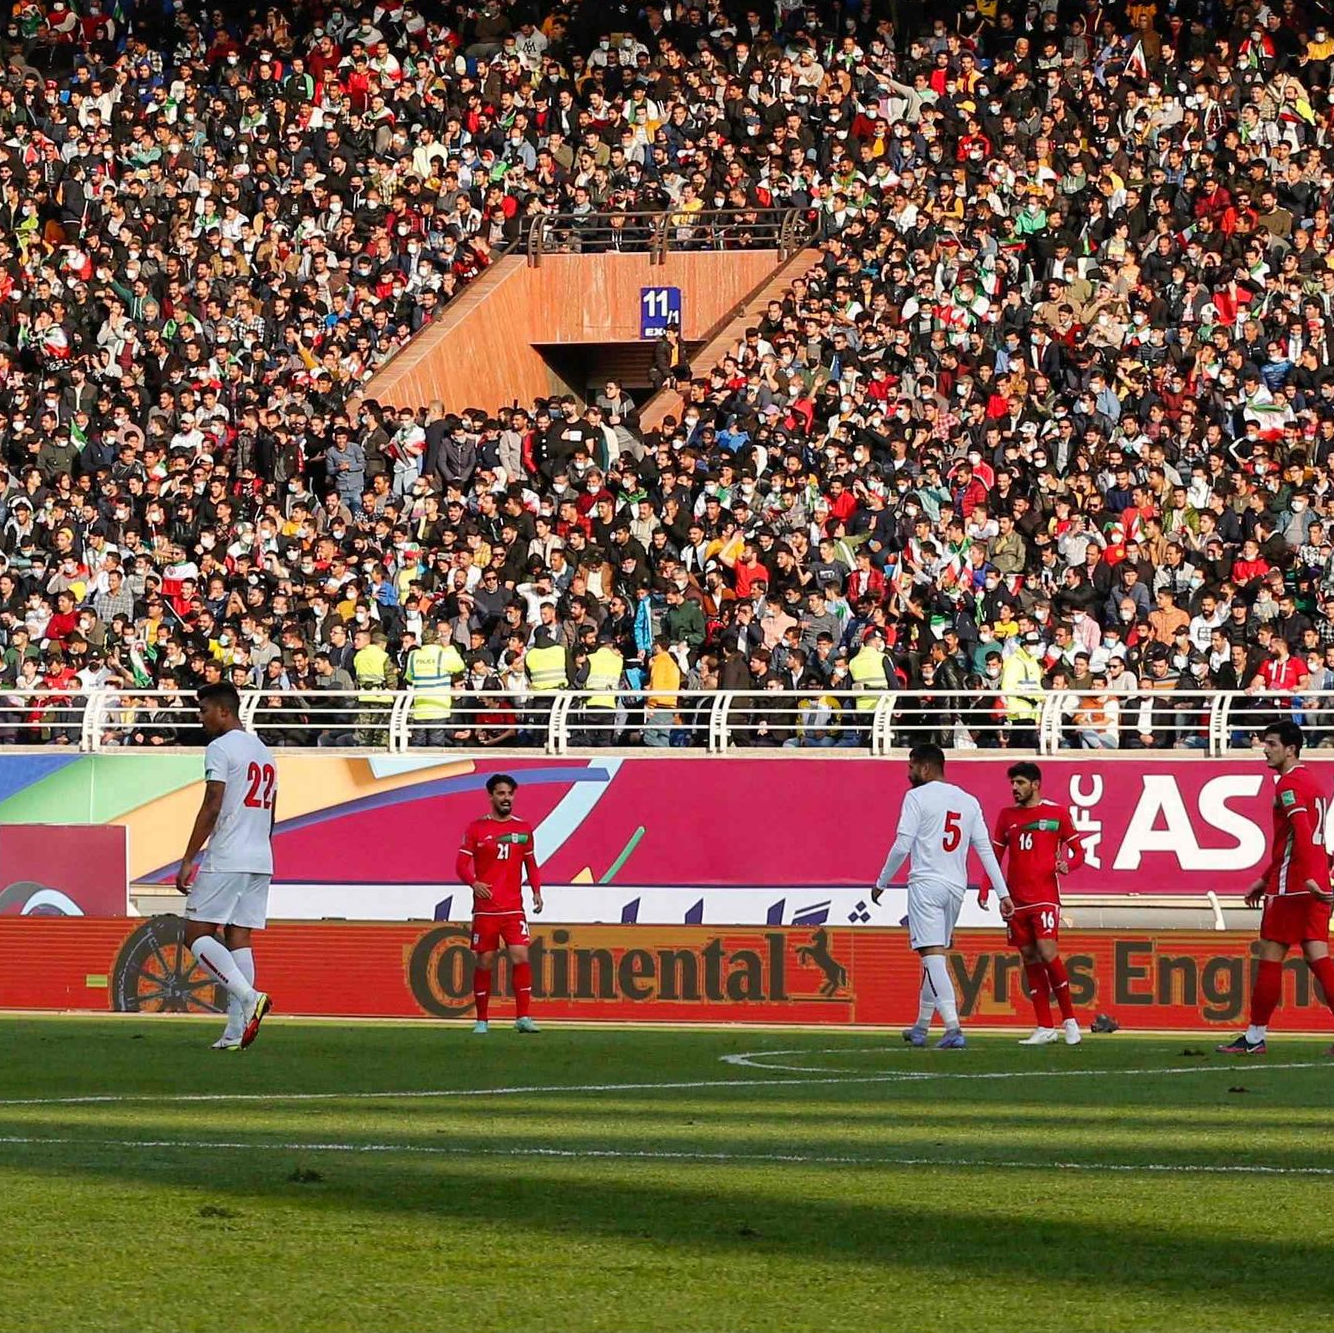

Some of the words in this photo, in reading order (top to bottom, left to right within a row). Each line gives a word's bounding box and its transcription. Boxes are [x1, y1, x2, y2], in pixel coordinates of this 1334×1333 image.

[645, 328, 667, 337] EX
[243, 761, 275, 809] 22
[942, 810, 962, 853] 5
[1019, 833, 1033, 850] 16
[496, 843, 509, 860] 21
[1041, 911, 1055, 929] 16
